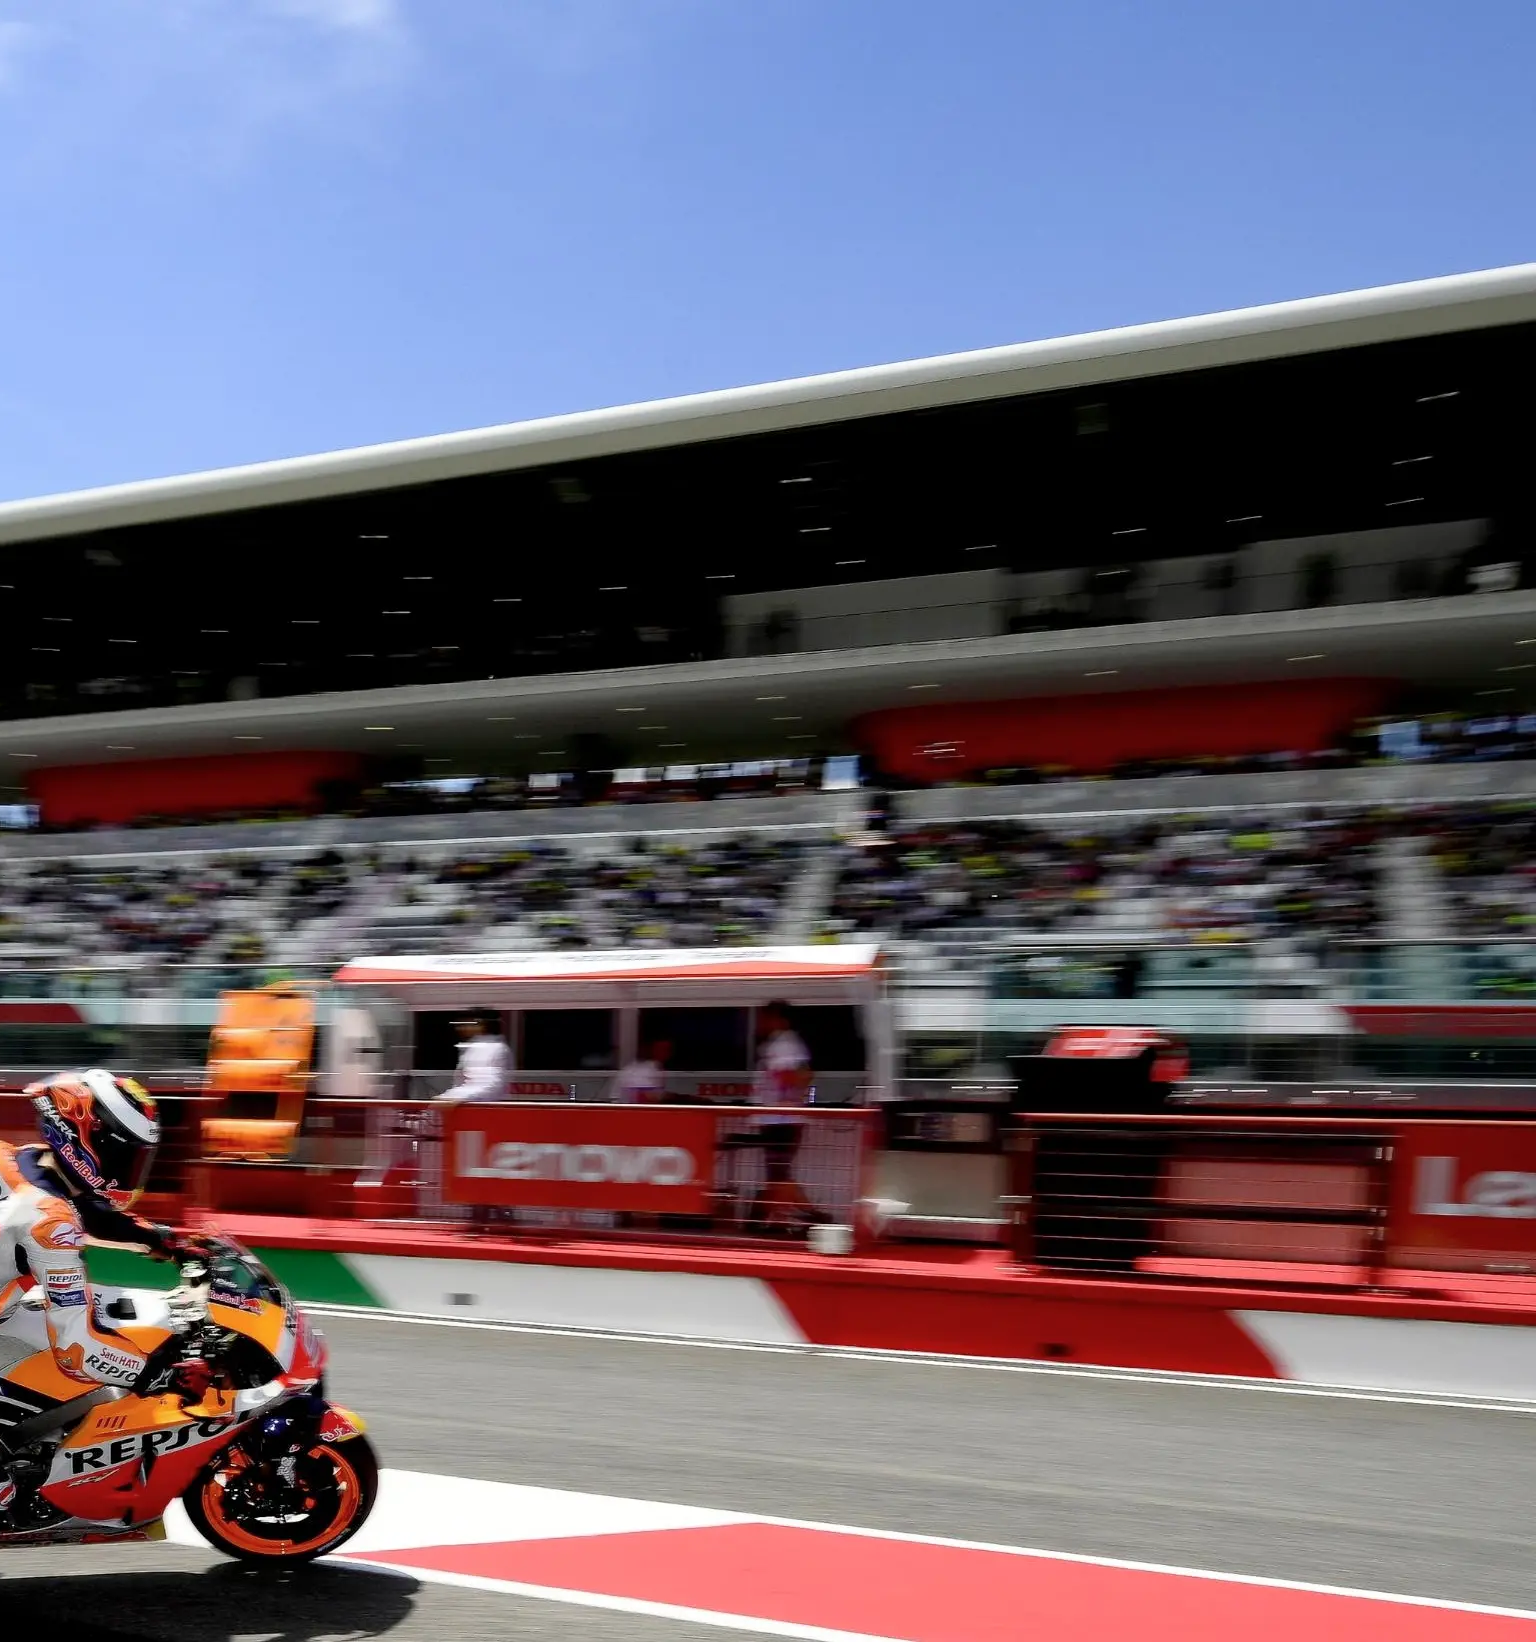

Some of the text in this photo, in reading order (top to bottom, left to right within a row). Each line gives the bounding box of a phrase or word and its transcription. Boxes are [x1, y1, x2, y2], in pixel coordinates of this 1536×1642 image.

[32, 1096, 78, 1141] SHARK
[455, 1130, 696, 1186] Lenovo
[85, 1353, 140, 1383] REPSO
[100, 1348, 119, 1362] Satu
